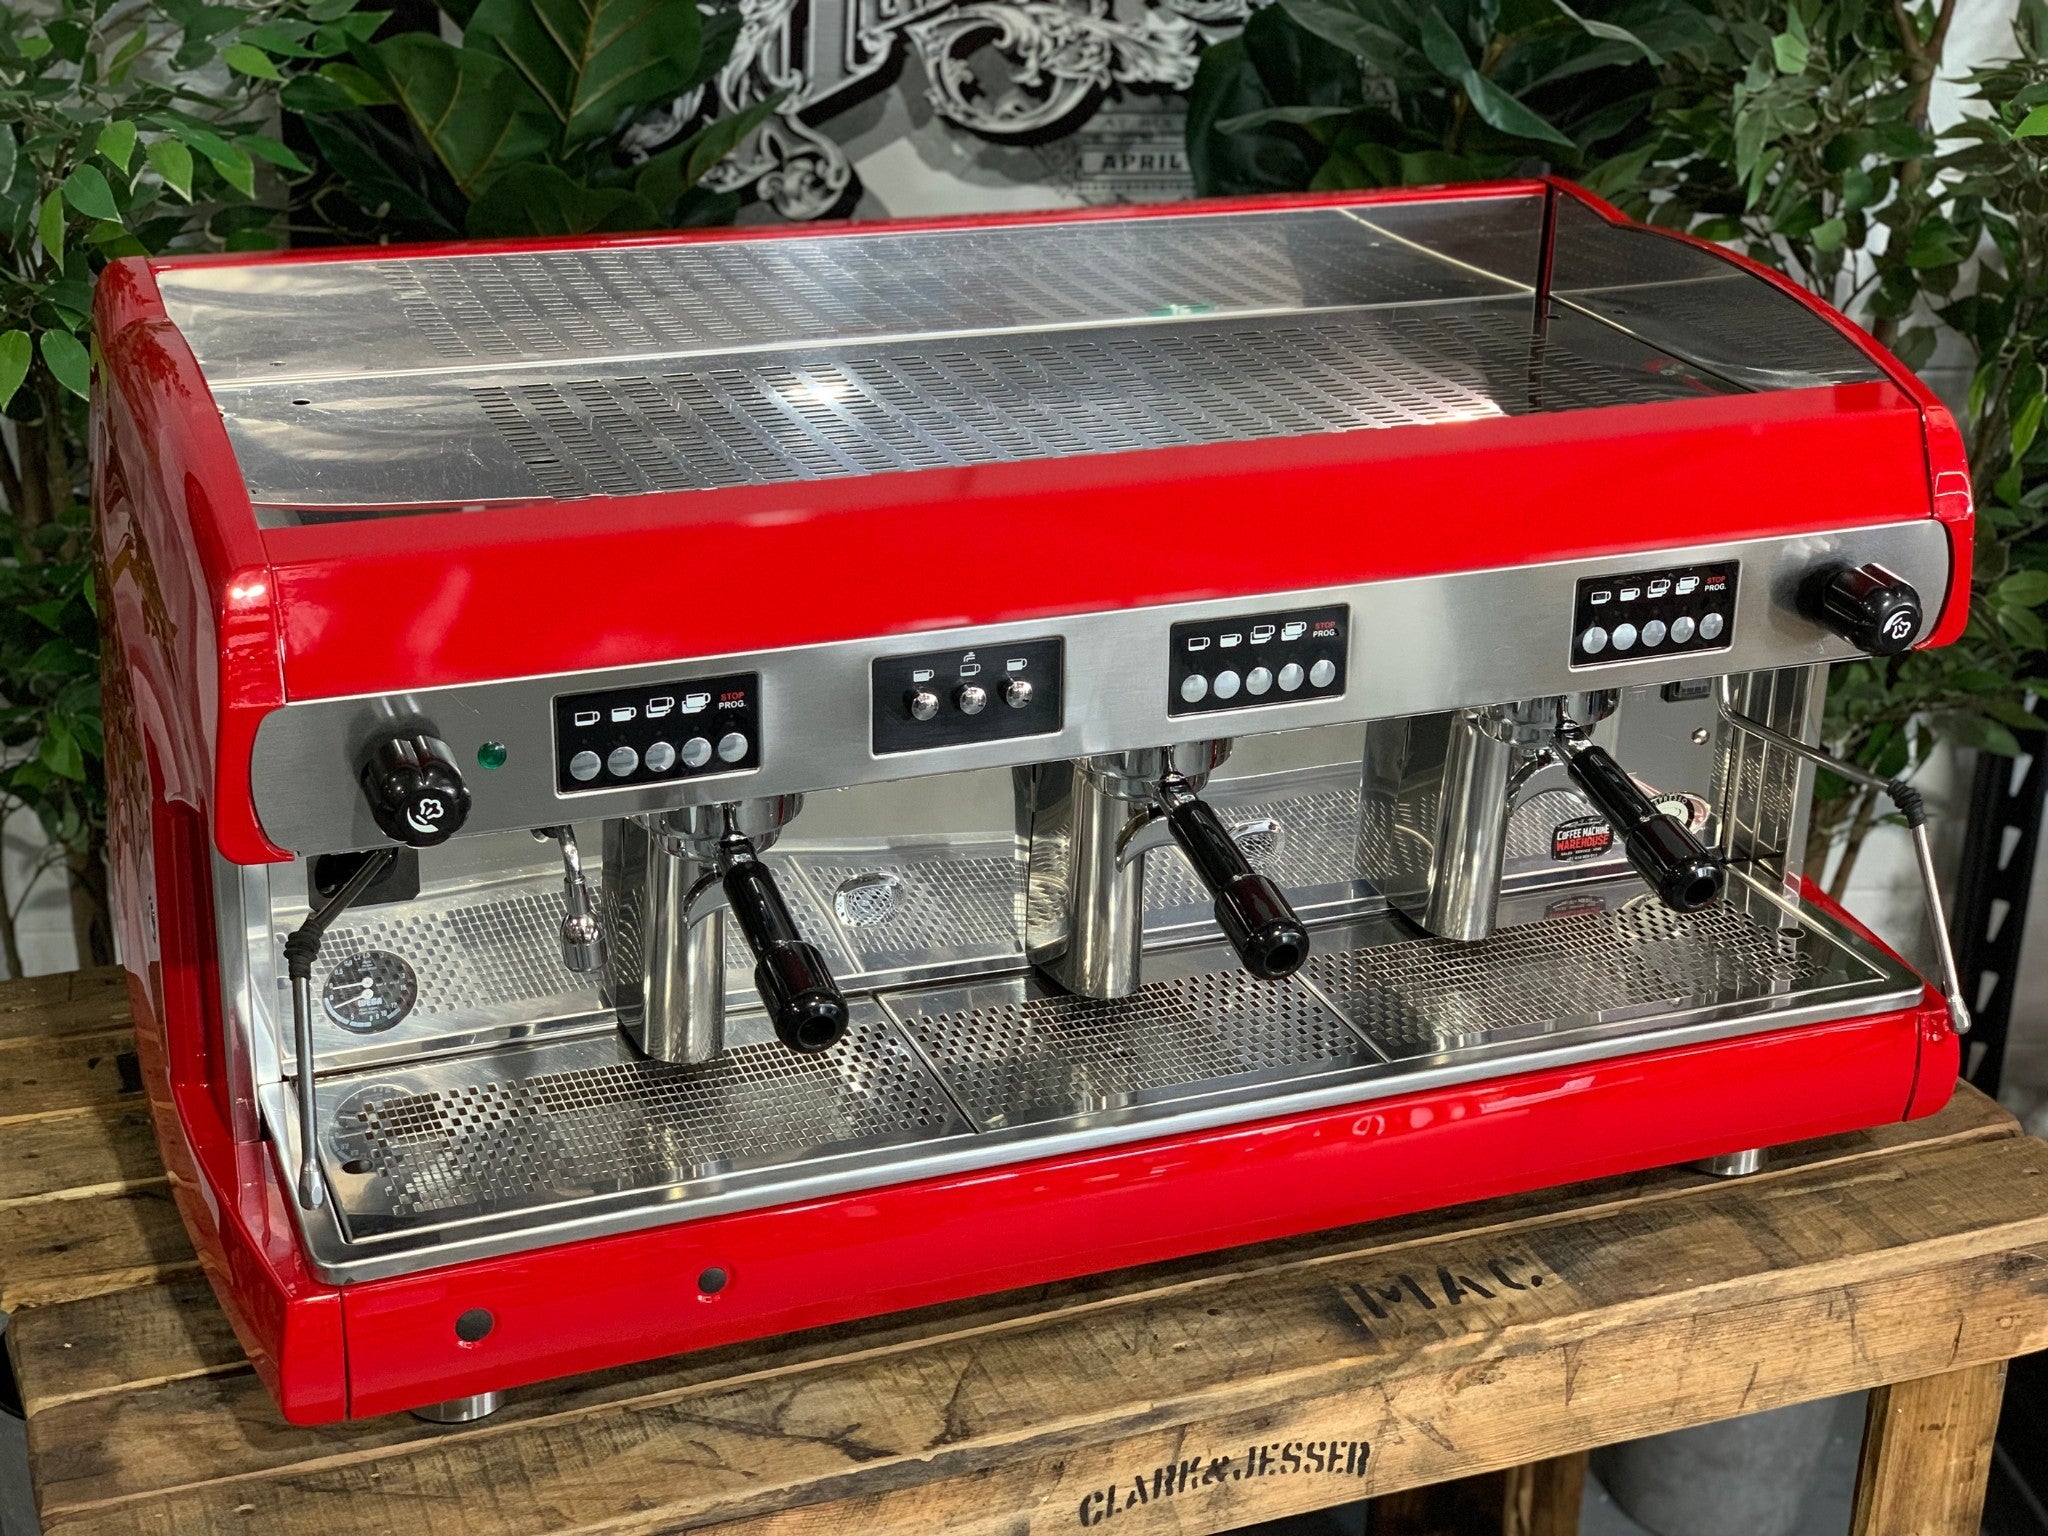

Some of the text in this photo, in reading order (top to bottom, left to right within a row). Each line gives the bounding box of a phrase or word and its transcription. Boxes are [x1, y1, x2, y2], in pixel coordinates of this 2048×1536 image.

[1102, 154, 1180, 169] APRIL
[1707, 576, 1726, 584] STOP
[1704, 583, 1726, 592] PROG.
[1315, 621, 1335, 629] STOP
[720, 691, 744, 701] STOP
[1556, 824, 1610, 840] COFFEE MACHINE
[1556, 835, 1608, 851] WAREHOUSE
[358, 998, 382, 1007] WEGA
[1079, 1441, 1371, 1527] CLARK&JESSER
